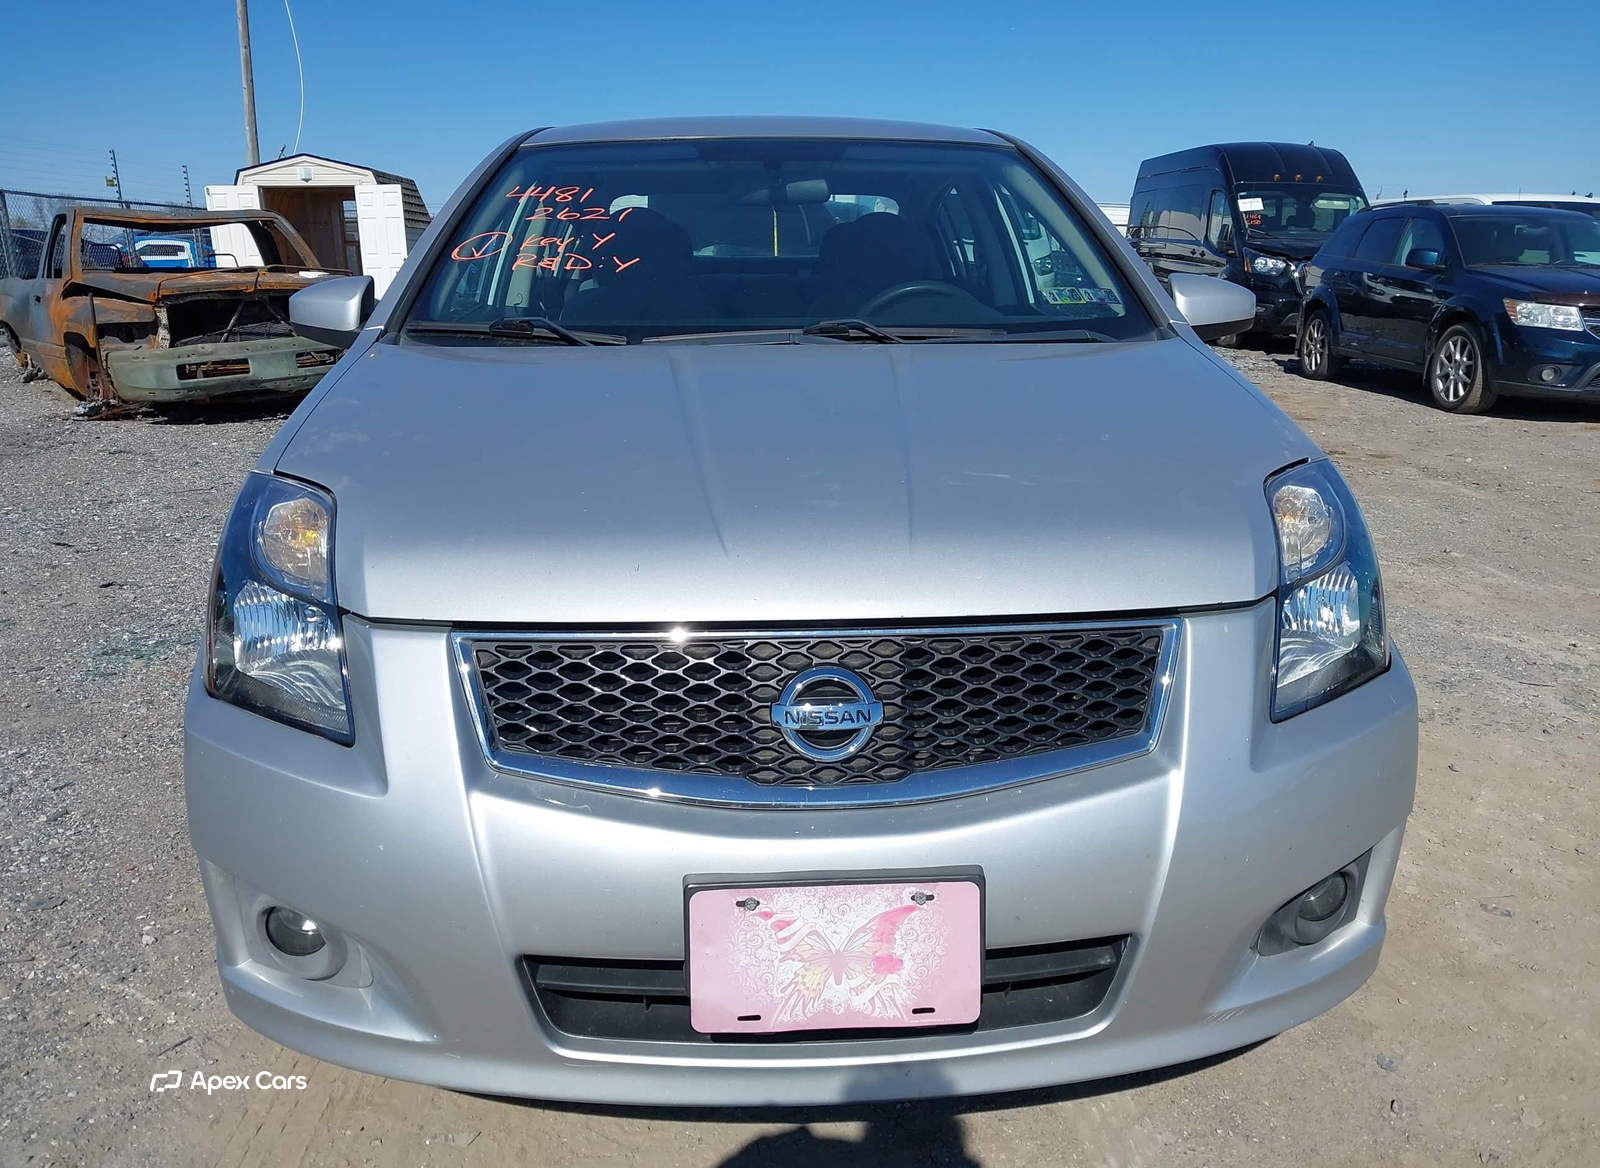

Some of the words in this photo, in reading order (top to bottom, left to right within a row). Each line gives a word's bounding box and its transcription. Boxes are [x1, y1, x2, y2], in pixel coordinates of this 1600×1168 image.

[505, 186, 594, 203] 4481
[592, 232, 616, 250] Y
[612, 257, 640, 273] Y
[784, 709, 871, 725] NISSAN
